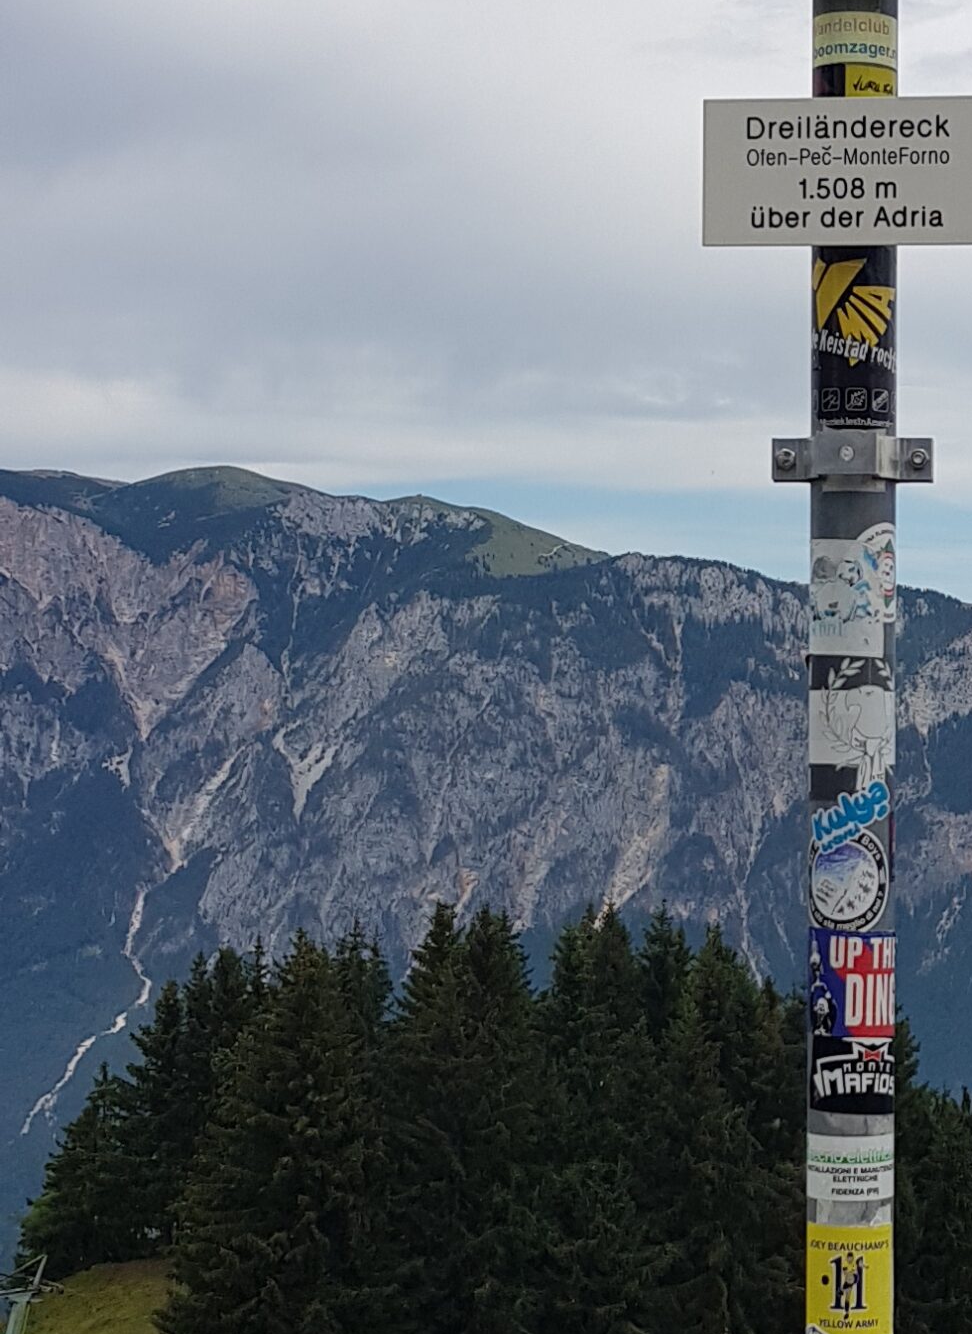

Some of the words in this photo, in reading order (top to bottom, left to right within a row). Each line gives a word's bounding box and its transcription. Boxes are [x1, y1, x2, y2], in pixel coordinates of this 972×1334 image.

[746, 114, 950, 140] Dreiländereck
[798, 177, 865, 200] 1.508
[875, 181, 898, 199] m
[751, 206, 811, 229] über
[820, 206, 864, 228] der
[873, 205, 944, 228] Adria
[819, 329, 869, 362] Keistad
[829, 935, 863, 970] UP
